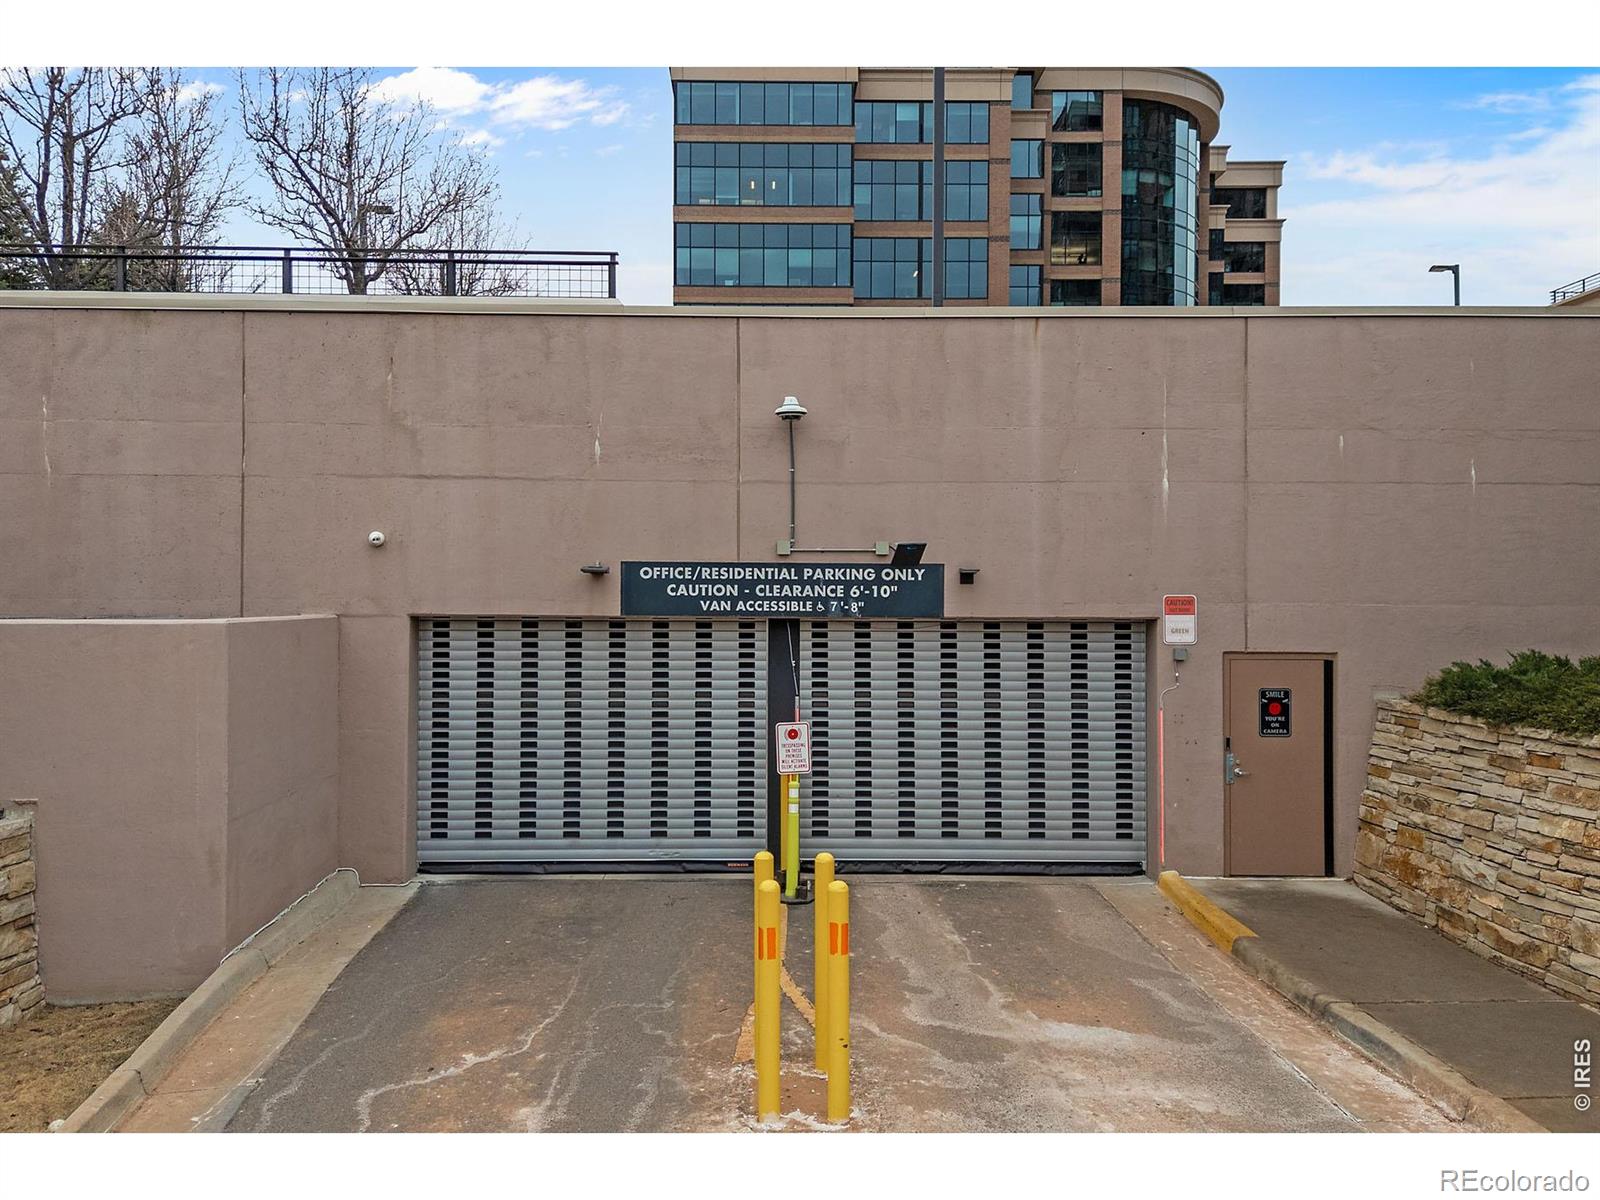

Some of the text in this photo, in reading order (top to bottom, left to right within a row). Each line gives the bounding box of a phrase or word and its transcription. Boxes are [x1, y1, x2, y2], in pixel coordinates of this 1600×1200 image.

[639, 566, 926, 581] OFFICE/RESIDENTIAL PARKING ONLY
[666, 584, 739, 596] CAUTION
[755, 584, 845, 597] CLEARANCE
[850, 585, 898, 598] 6'-10"
[700, 600, 731, 611] VAN
[736, 601, 813, 612] ACCESSIBLE
